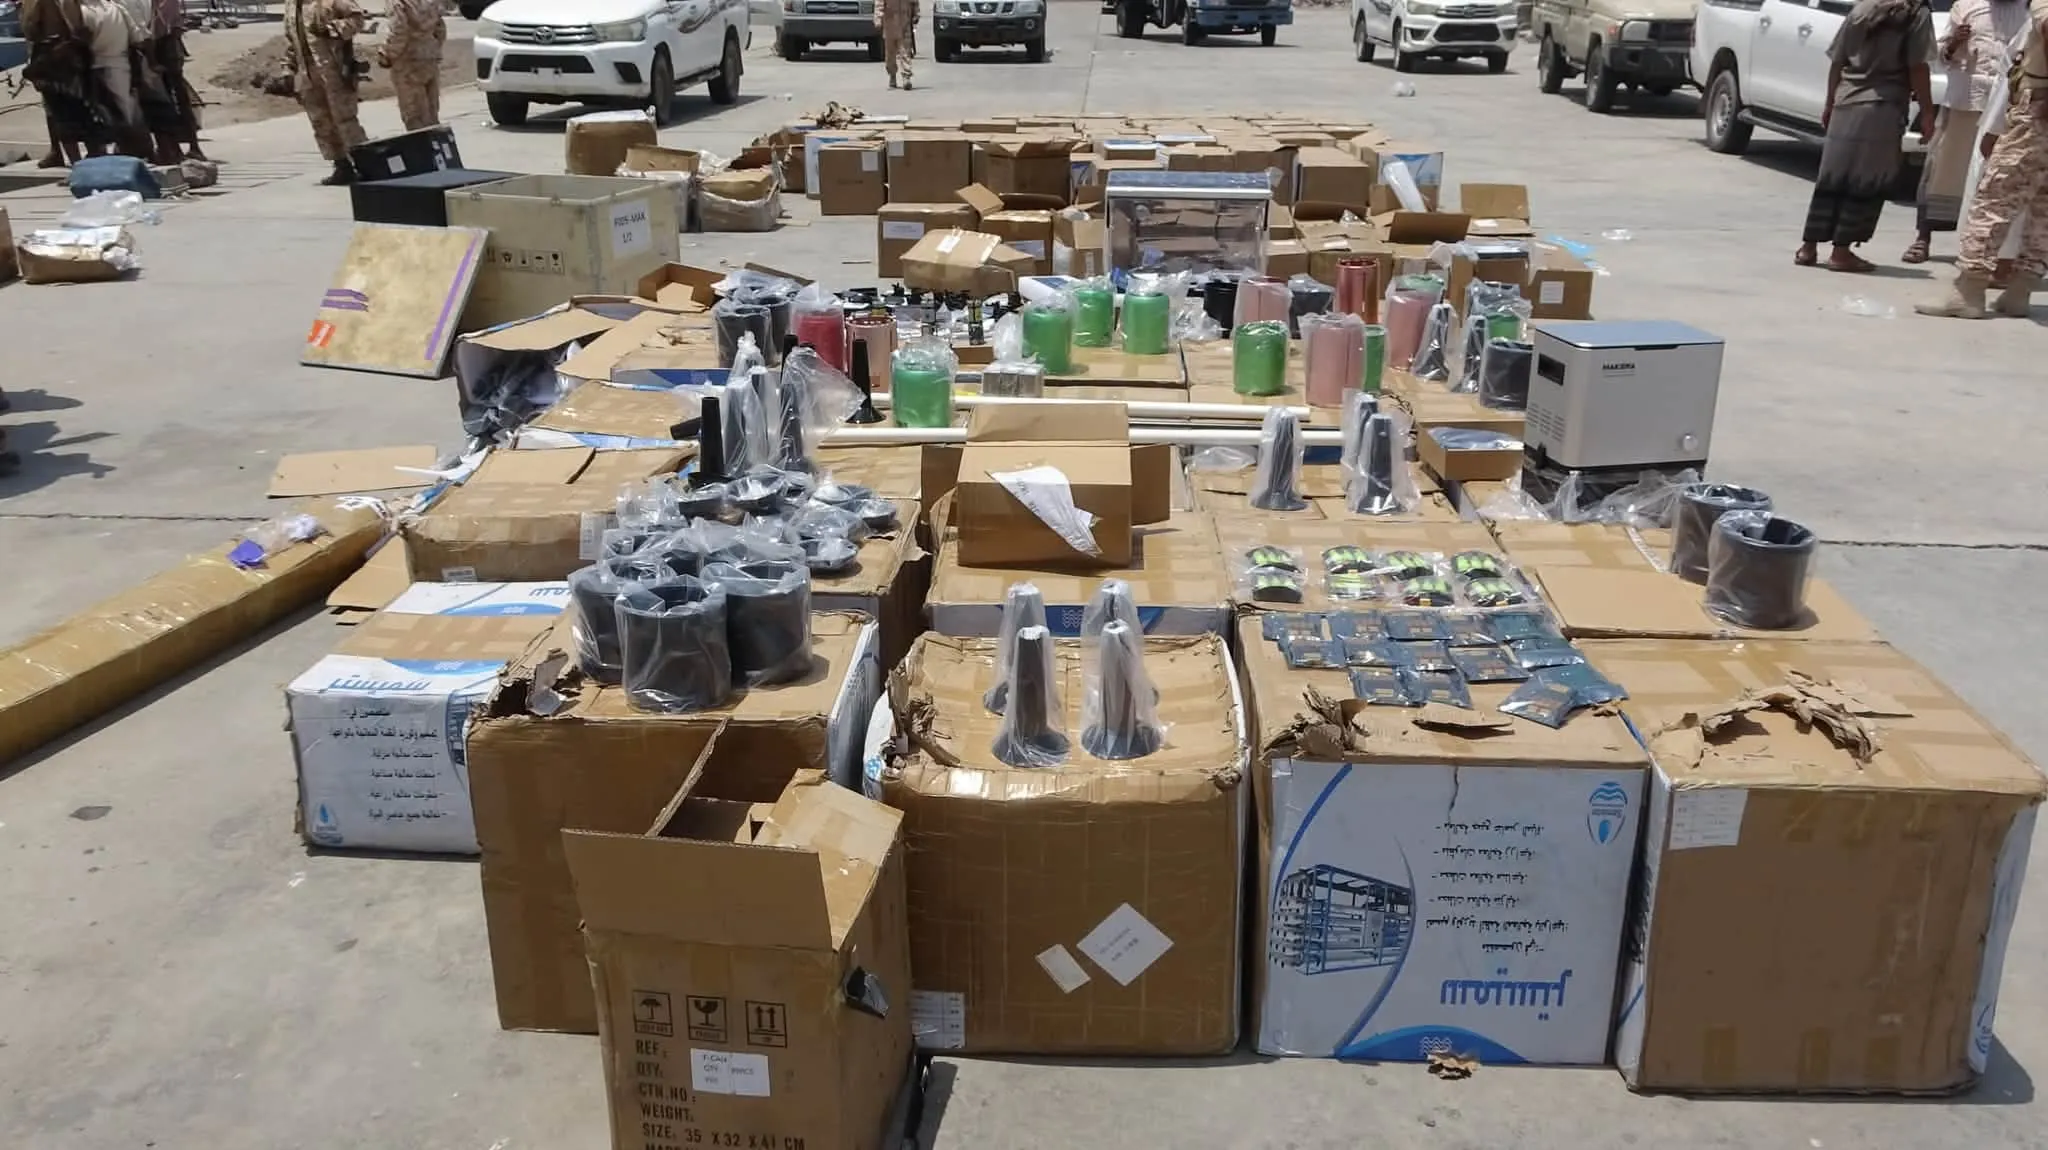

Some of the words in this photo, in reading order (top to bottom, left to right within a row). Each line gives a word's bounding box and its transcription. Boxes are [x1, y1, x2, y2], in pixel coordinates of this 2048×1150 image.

[1440, 968, 1573, 1021] سميستر
[685, 1128, 702, 1143] 35
[723, 1132, 740, 1147] 32
[761, 1133, 776, 1149] 41
[784, 1136, 805, 1150] CM
